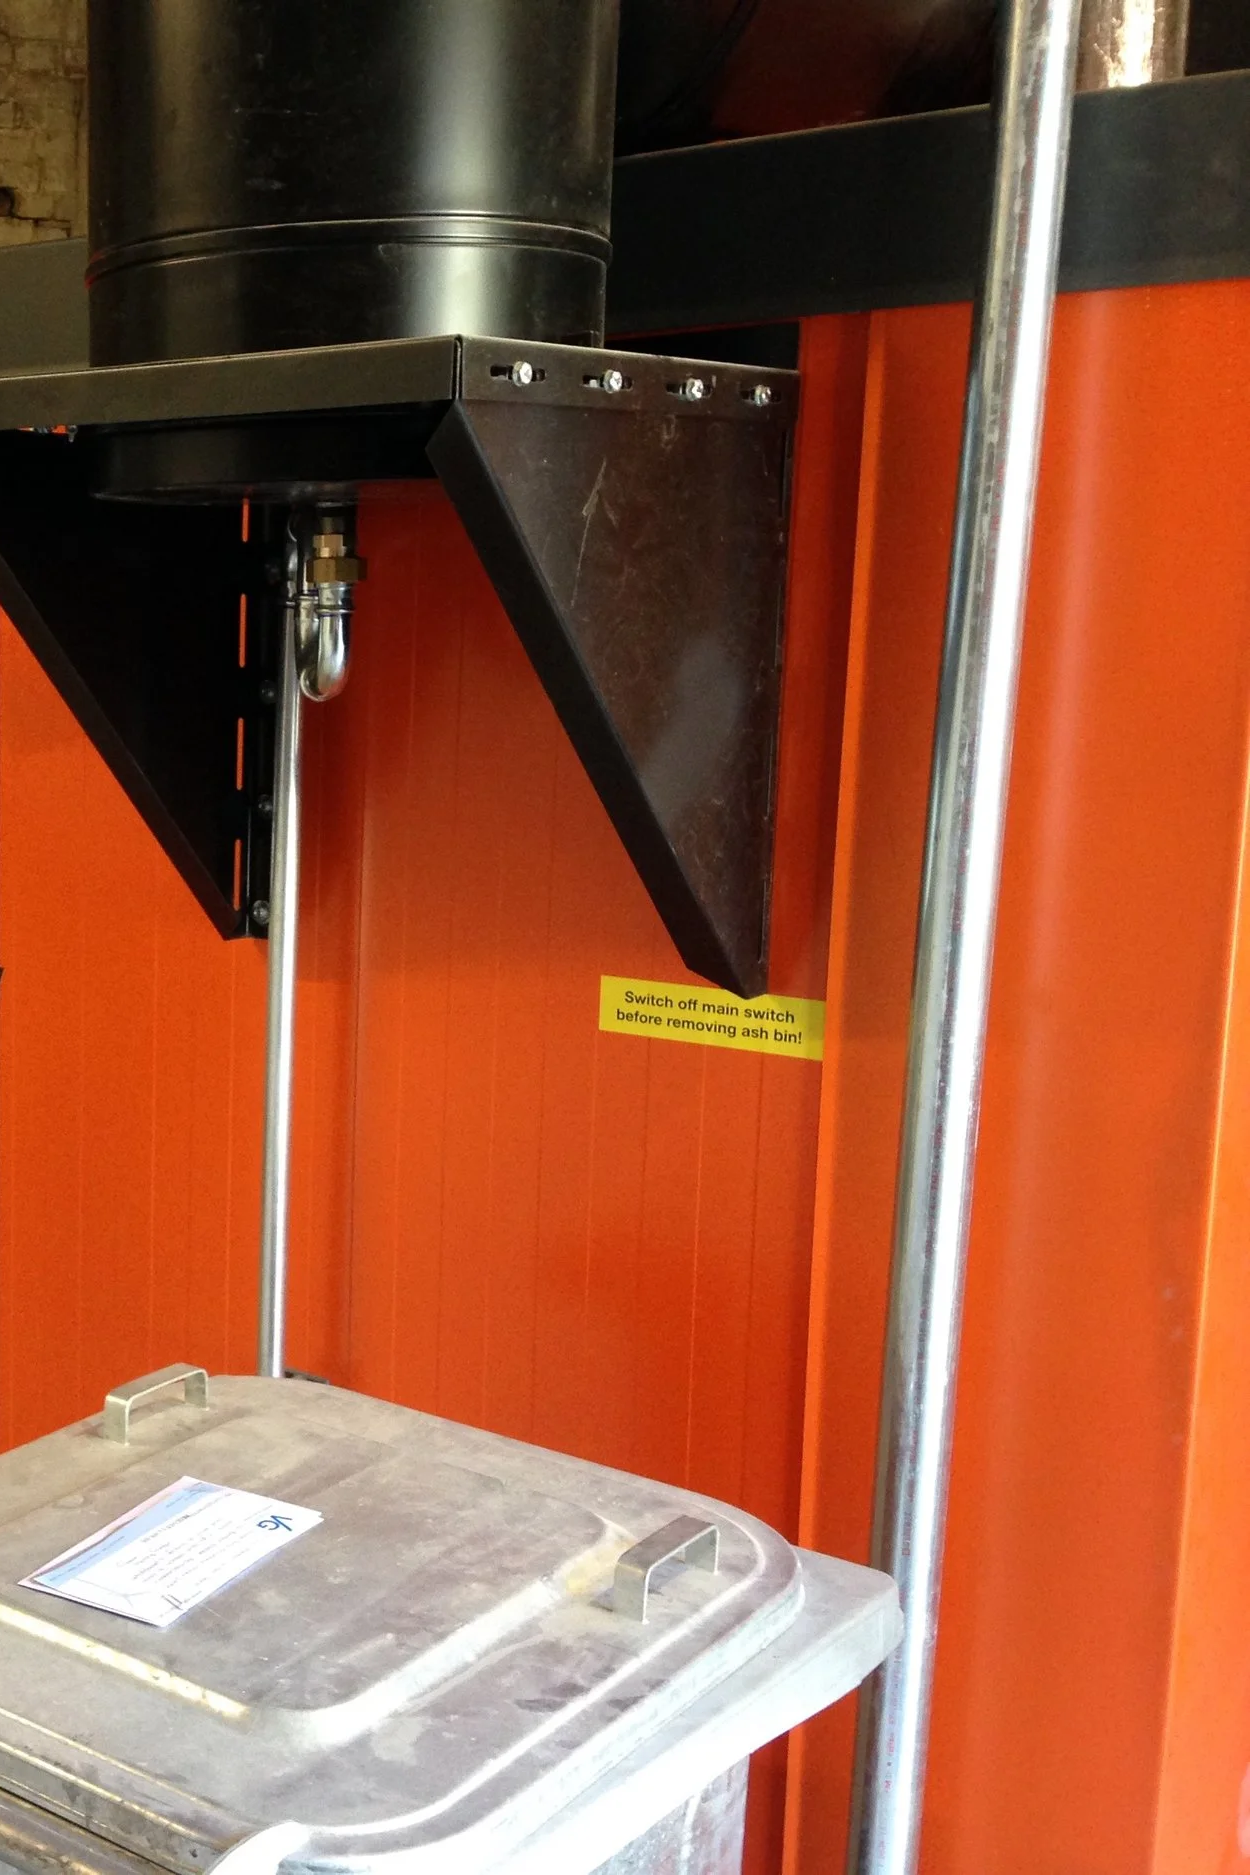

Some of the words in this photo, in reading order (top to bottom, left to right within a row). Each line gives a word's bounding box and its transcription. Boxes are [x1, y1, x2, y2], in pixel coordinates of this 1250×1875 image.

[624, 990, 673, 1009] Switch
[678, 998, 699, 1012] off
[702, 1003, 739, 1017] main
[744, 1007, 795, 1024] switch
[616, 1009, 662, 1026] before
[666, 1018, 737, 1038] removing
[741, 1026, 769, 1042] ash
[774, 1029, 803, 1045] bin!
[256, 1514, 293, 1532] VG
